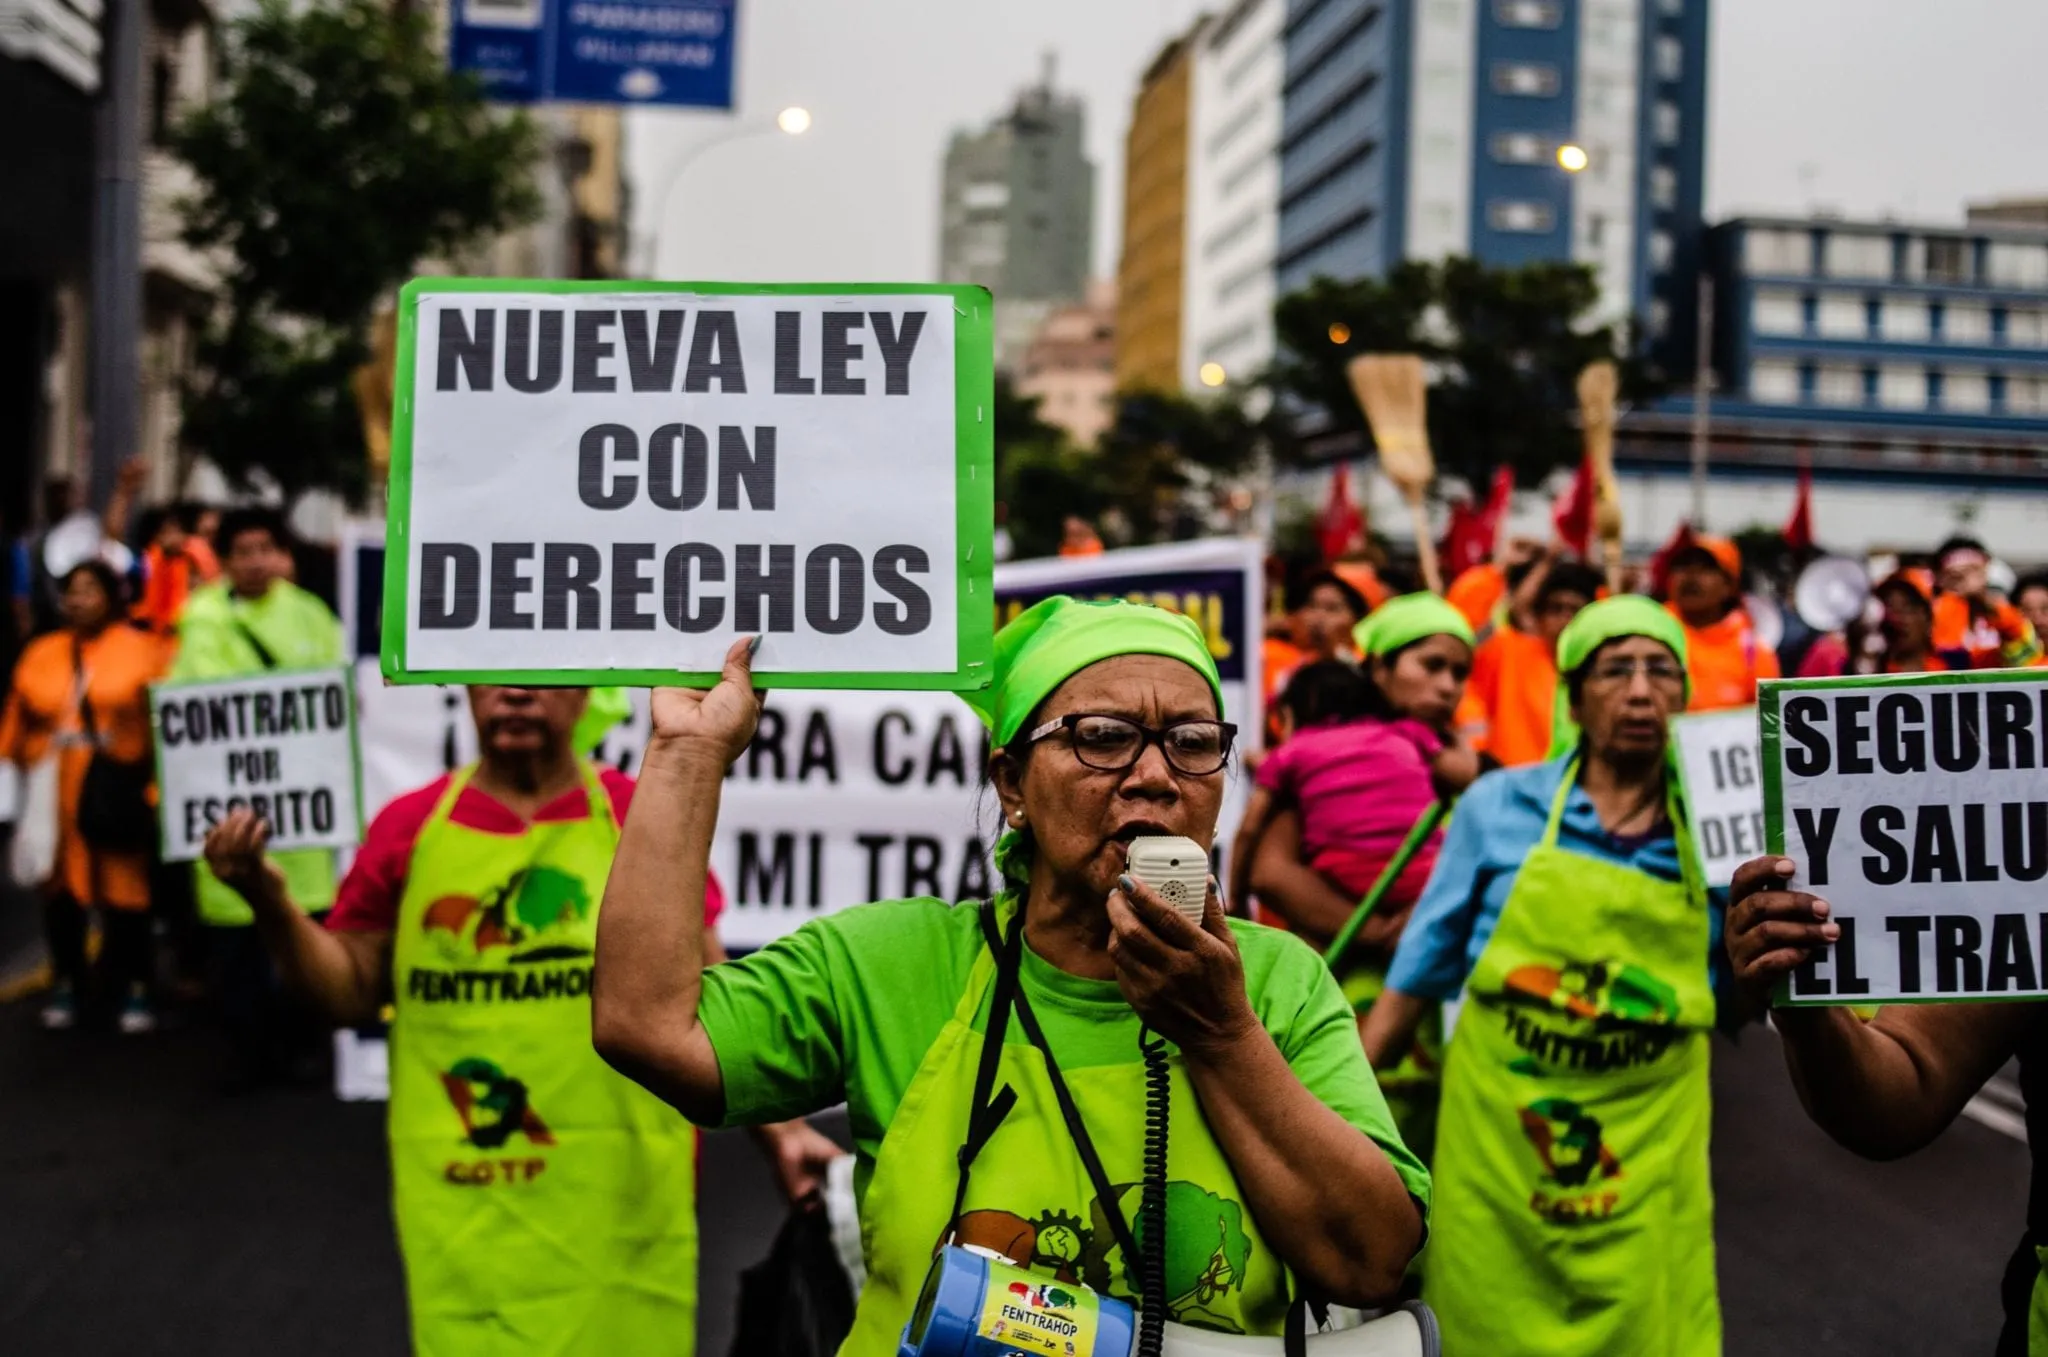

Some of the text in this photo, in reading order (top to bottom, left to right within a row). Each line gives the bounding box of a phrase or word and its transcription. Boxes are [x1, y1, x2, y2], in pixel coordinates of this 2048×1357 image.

[436, 307, 927, 396] NUEVA LEY
[578, 423, 777, 512] CON
[418, 541, 932, 636] DERECHOS
[160, 683, 345, 747] CONTRATO
[228, 748, 280, 785] POR
[184, 787, 335, 843] ESRITO
[1793, 807, 1841, 886] Y
[1001, 1304, 1078, 1337] FENTTRAHOP
